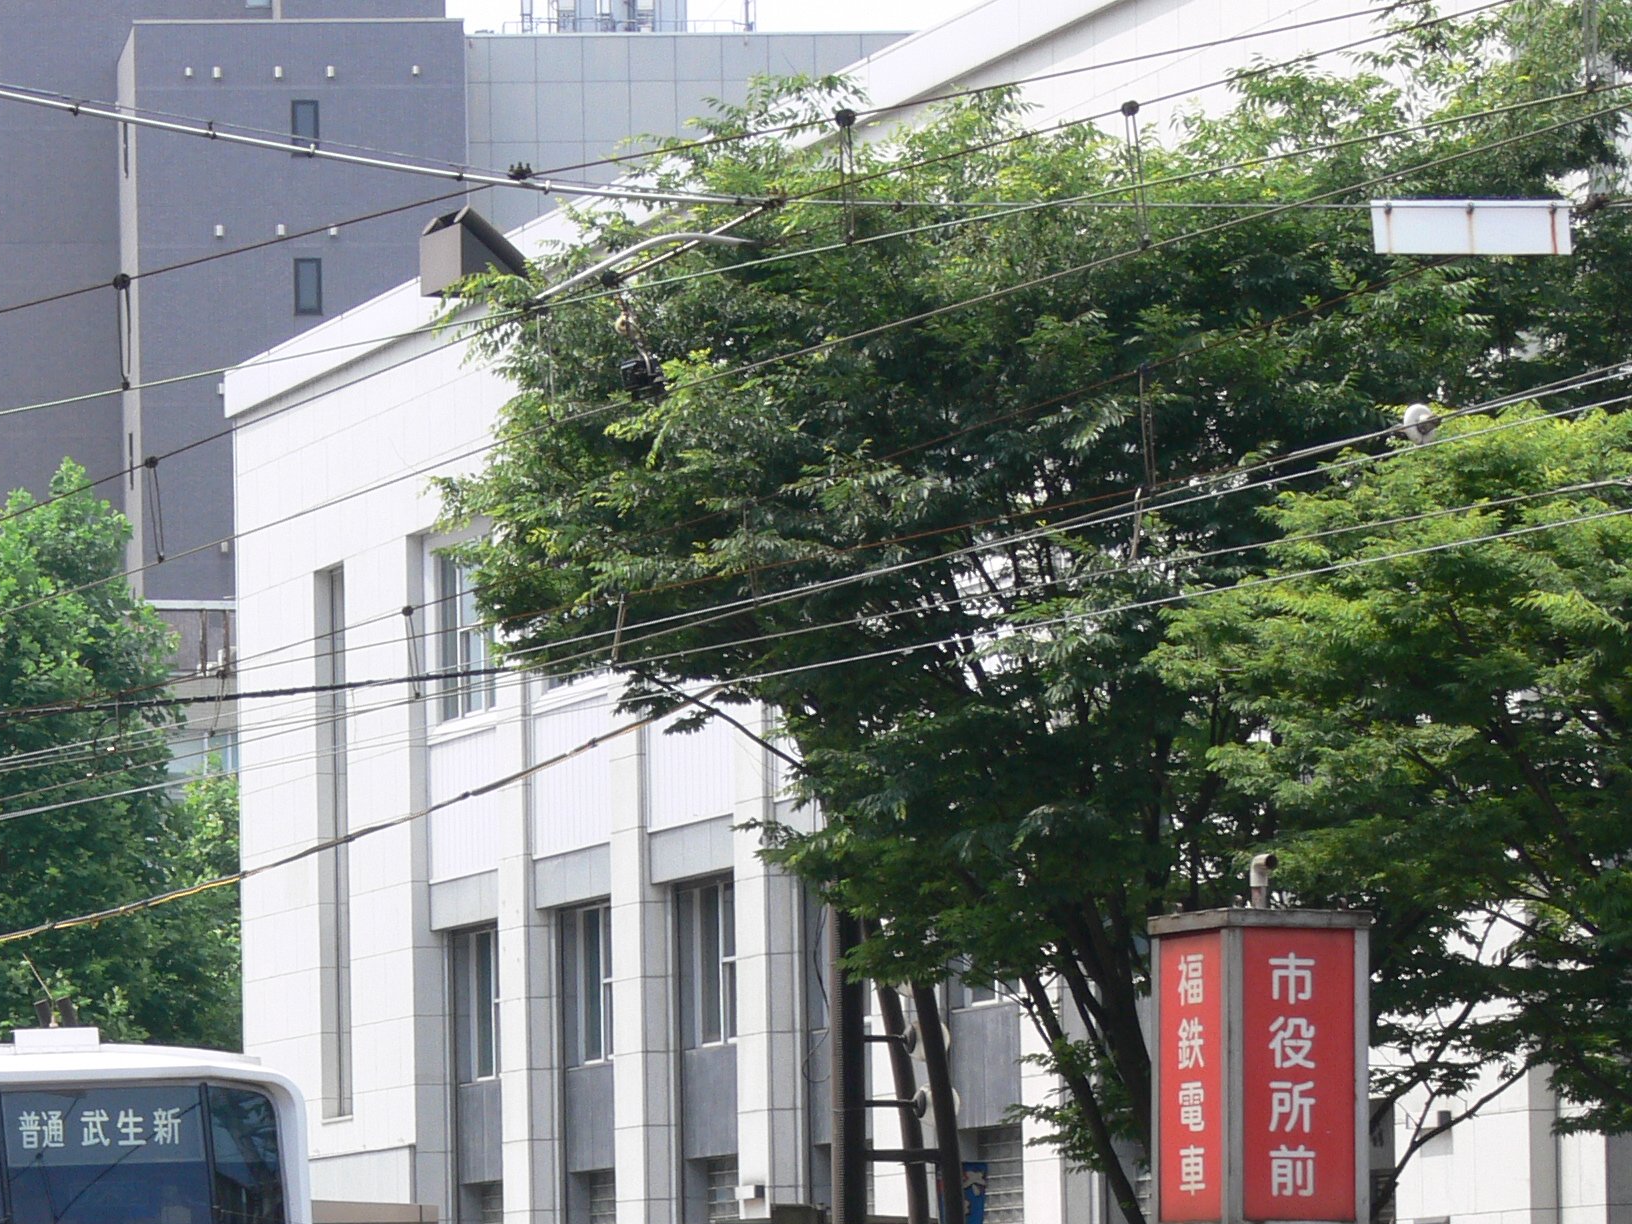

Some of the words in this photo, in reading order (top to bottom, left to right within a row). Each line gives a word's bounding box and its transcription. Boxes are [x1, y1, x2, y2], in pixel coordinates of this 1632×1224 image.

[18, 1110, 66, 1149] 普通
[80, 1107, 182, 1147] 武生新
[1177, 953, 1205, 1197] 福鉄電車
[1267, 952, 1316, 1198] 市役所前
